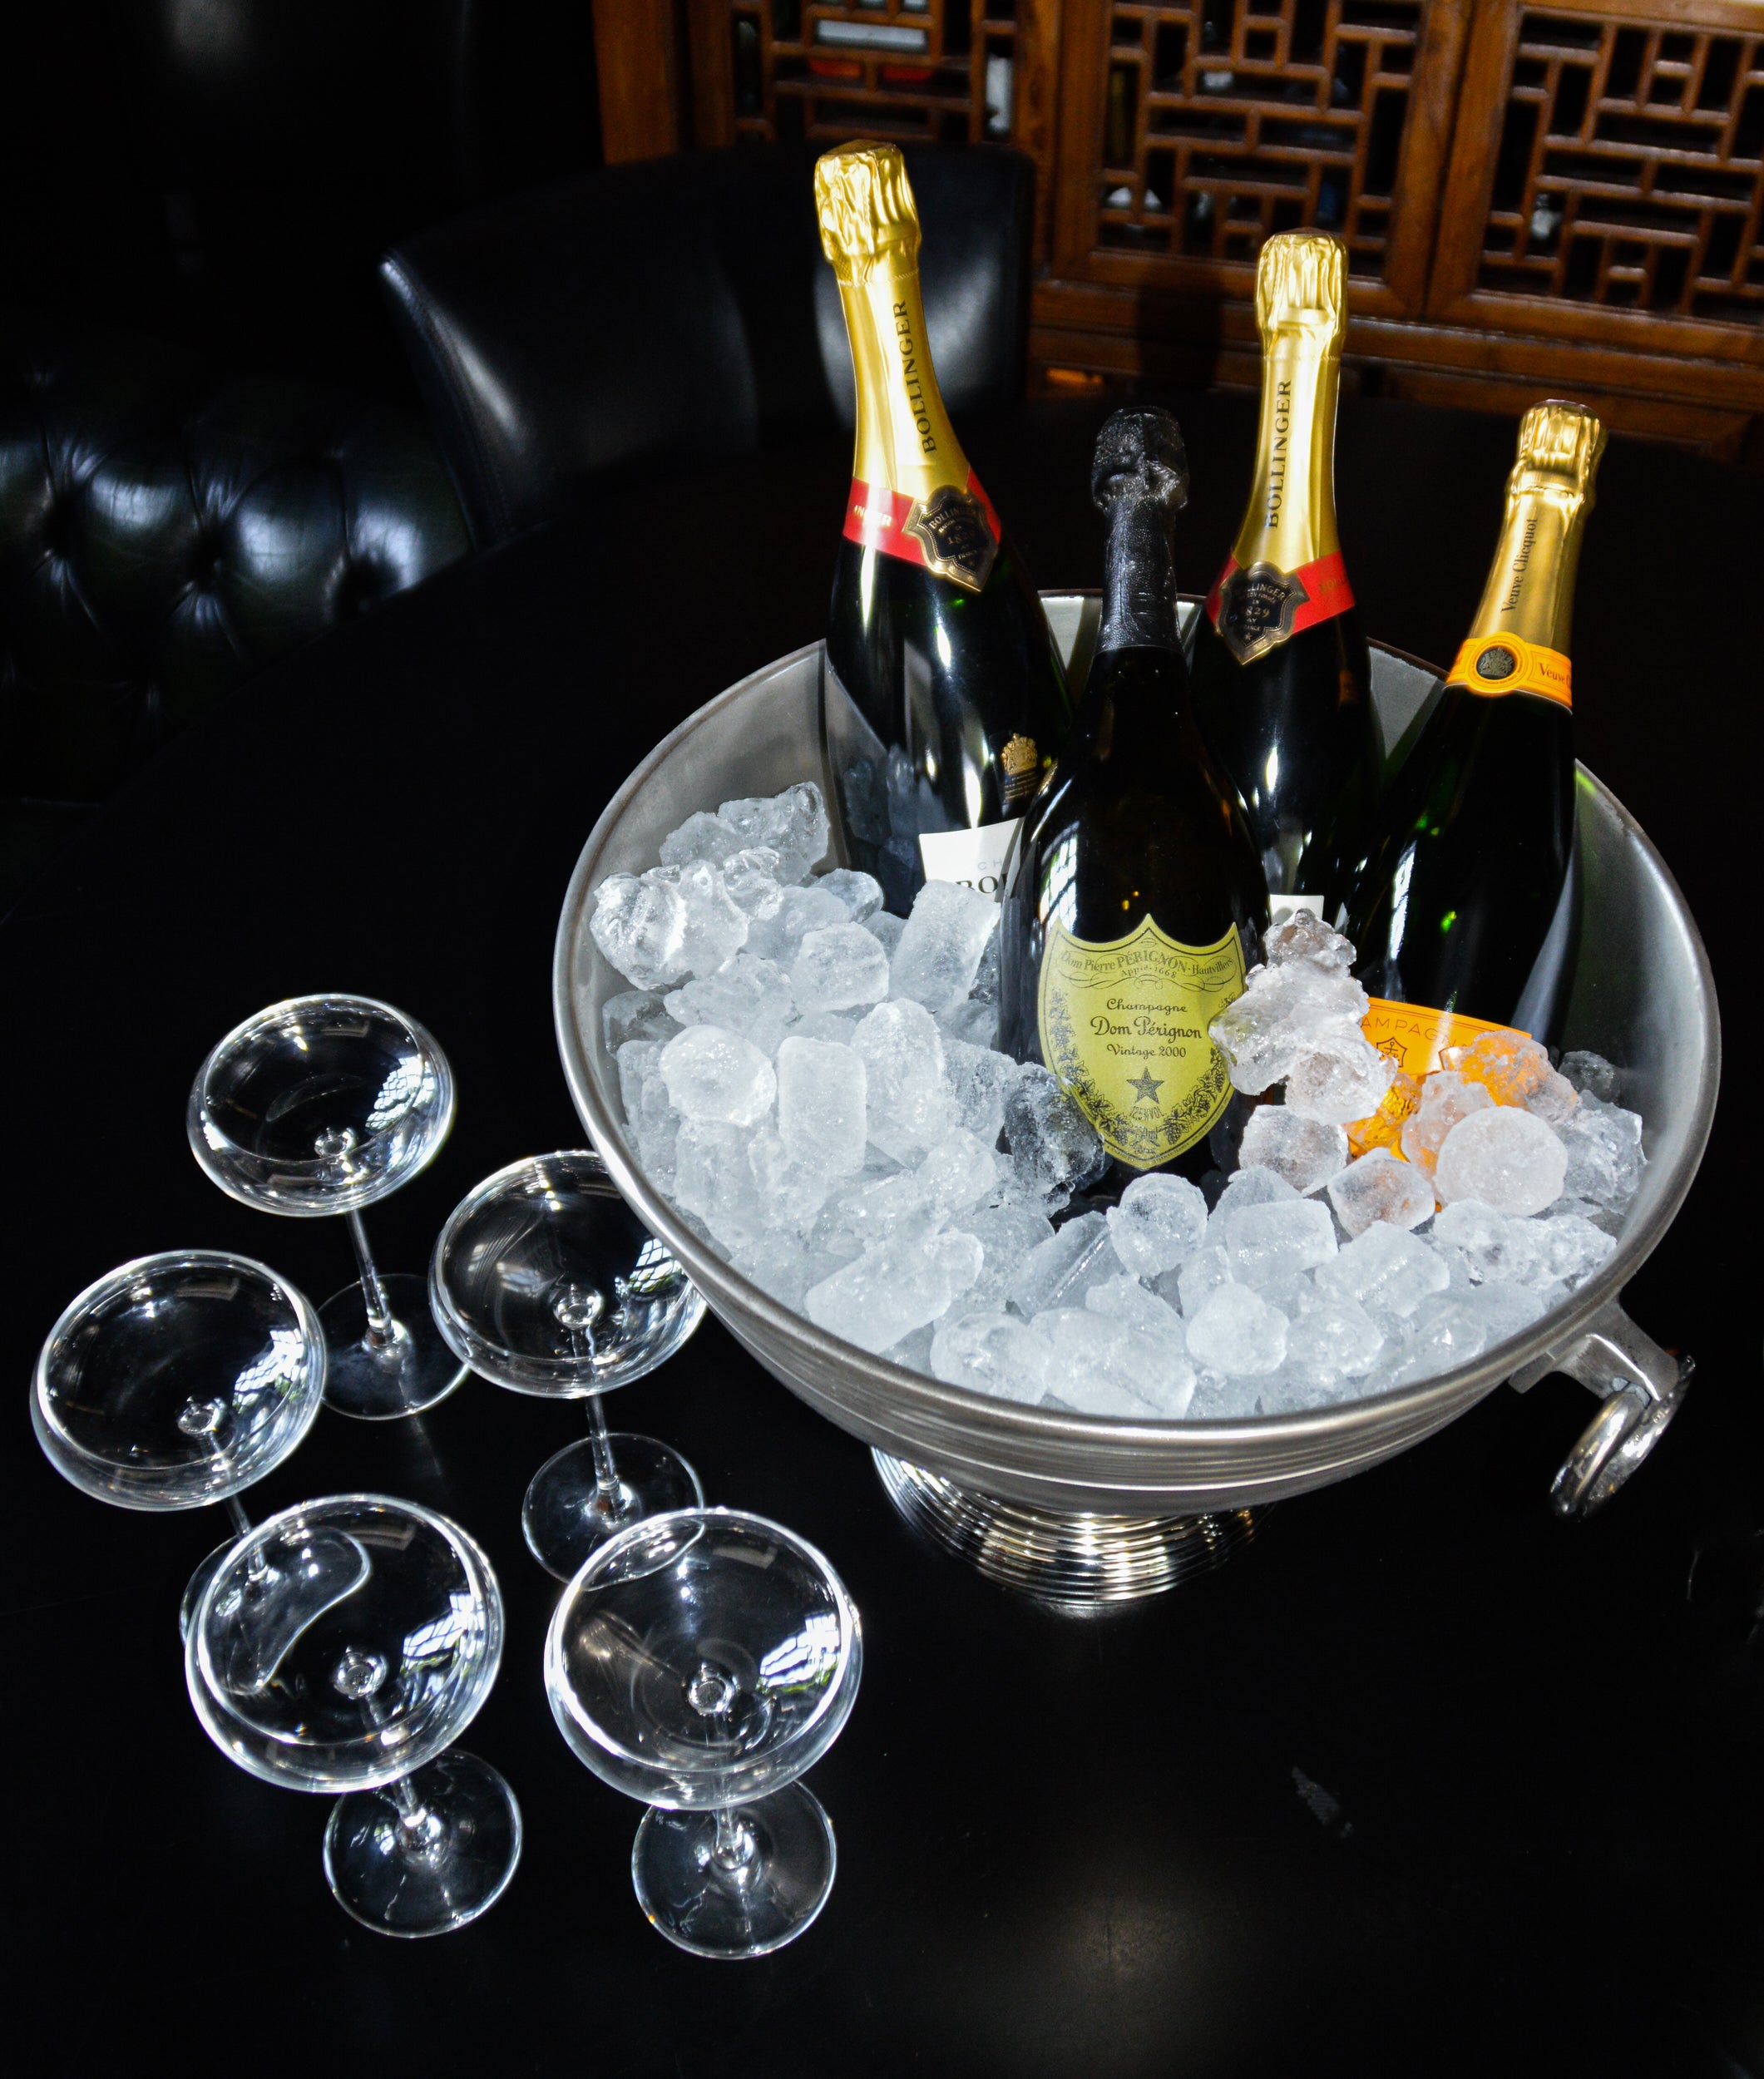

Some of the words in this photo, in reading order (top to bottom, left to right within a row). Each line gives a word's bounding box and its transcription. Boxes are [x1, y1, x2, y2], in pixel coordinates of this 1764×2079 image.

[893, 299, 937, 453] BOLLINGER
[1264, 379, 1292, 528] BOLLINGER
[1501, 575, 1524, 612] Veuve
[1513, 519, 1538, 572] Clicquot
[1538, 662, 1565, 682] Veuve
[1061, 951, 1083, 969] Dom
[1085, 959, 1116, 971] Pierre
[1117, 950, 1188, 973] PÉRIGNON
[1192, 958, 1233, 975] Hautvillers
[1107, 998, 1188, 1015] Champagne
[1090, 1016, 1131, 1035] Dom
[1134, 1016, 1203, 1044] Pérignon
[1107, 1044, 1155, 1059] Vintage
[1159, 1046, 1187, 1057] 2000
